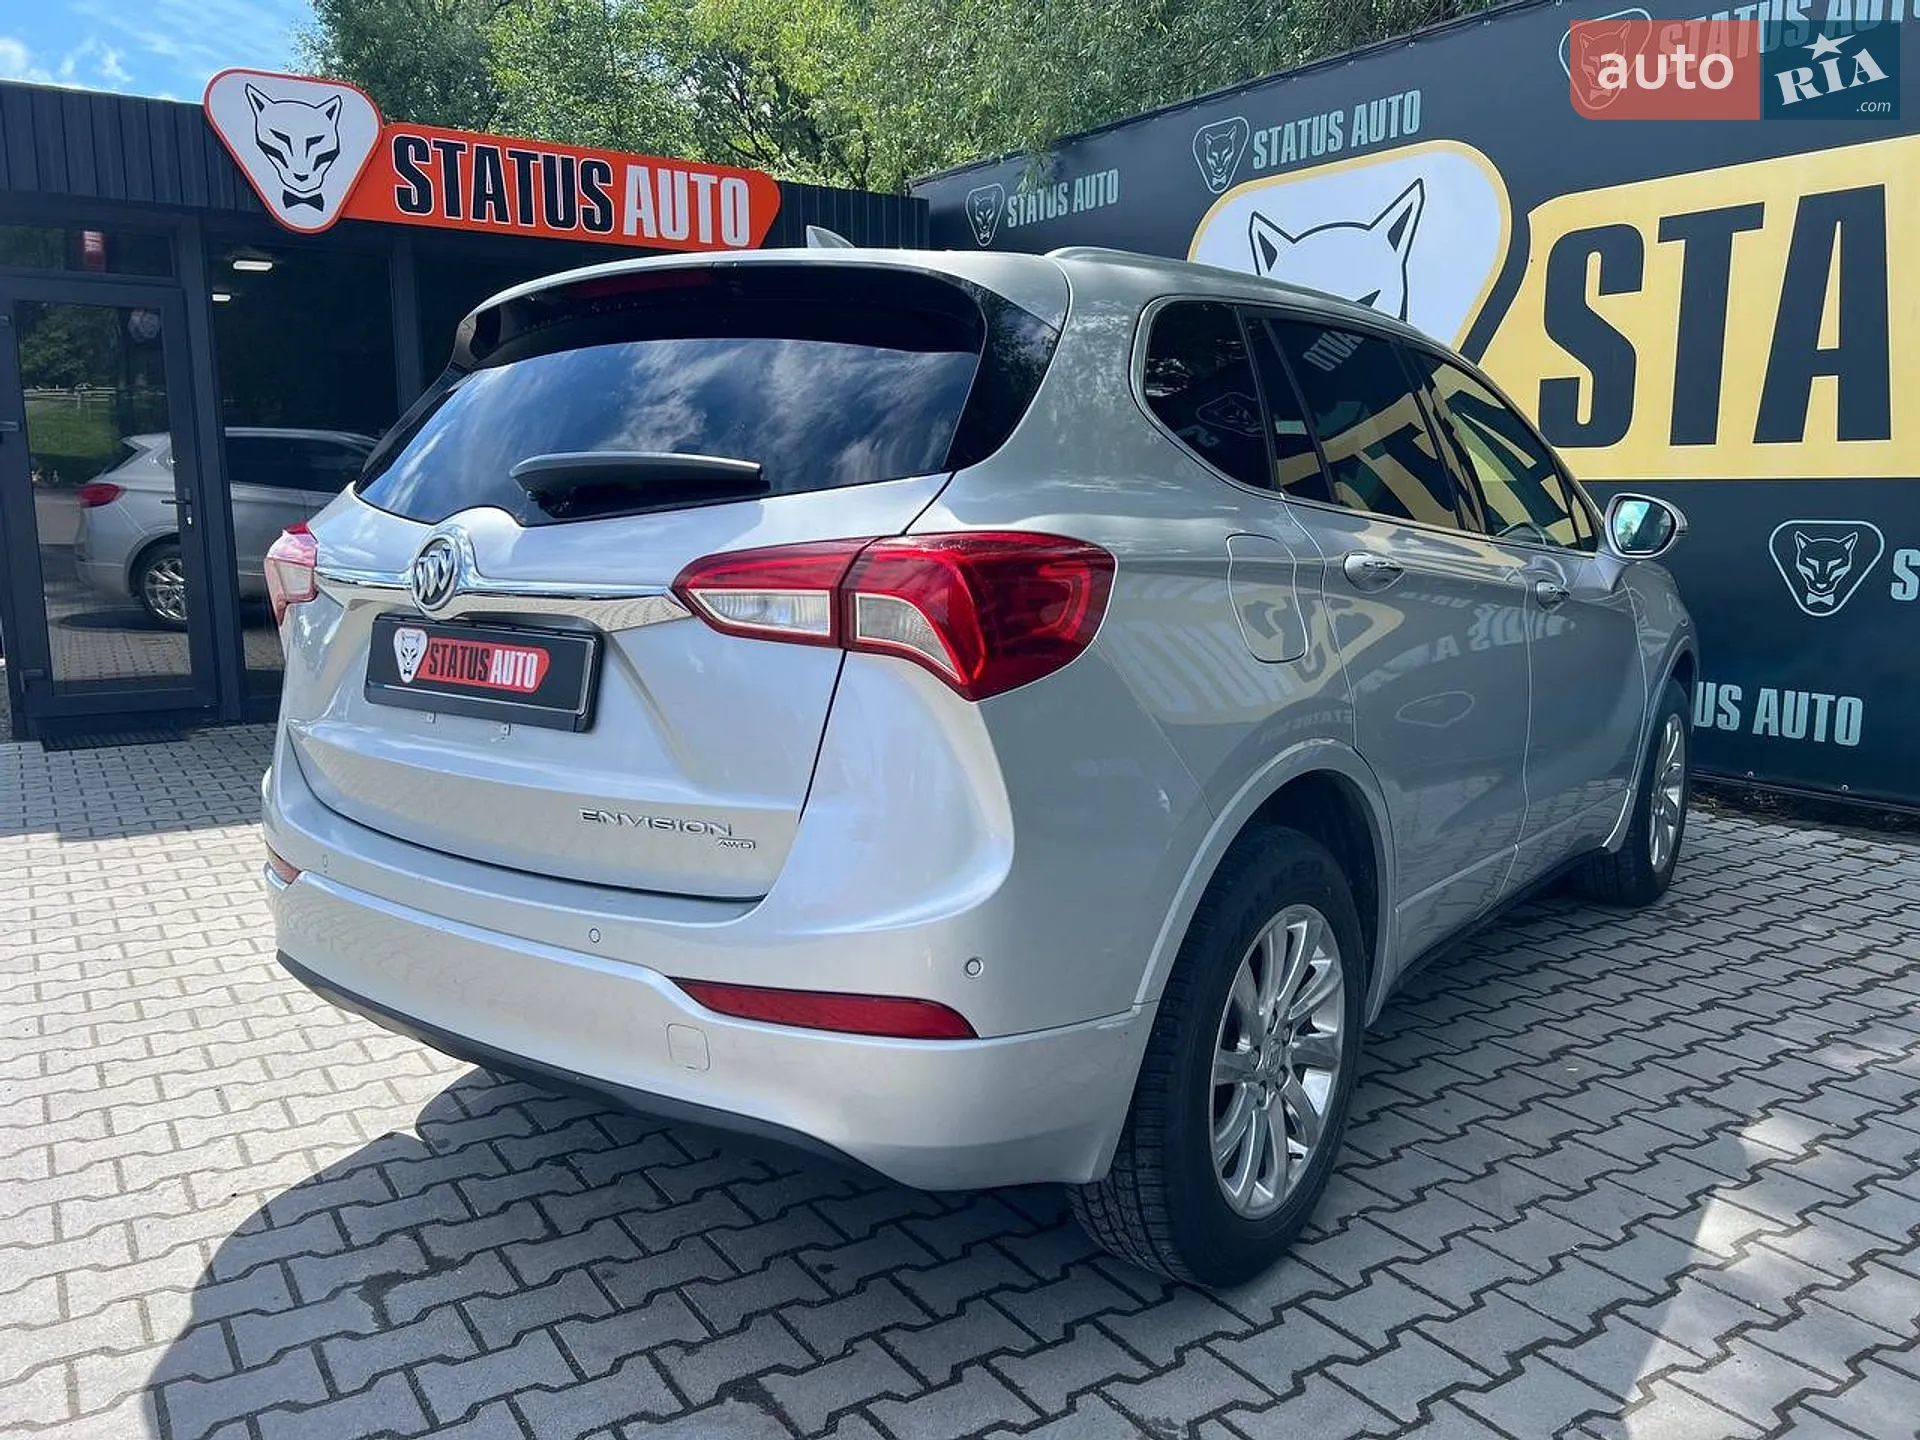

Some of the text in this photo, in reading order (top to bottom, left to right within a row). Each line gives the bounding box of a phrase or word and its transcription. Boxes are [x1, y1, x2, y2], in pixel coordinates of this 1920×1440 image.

[1252, 90, 1422, 170] STATUS AUTO
[391, 133, 752, 248] STATUS AUTO
[1007, 168, 1119, 228] STATUS AUTO
[1538, 183, 1892, 448] STA
[429, 642, 538, 689] STATUS AUTO
[1752, 687, 1863, 746] AUTO
[579, 807, 733, 837] ENVISION
[718, 838, 756, 850] AWD
